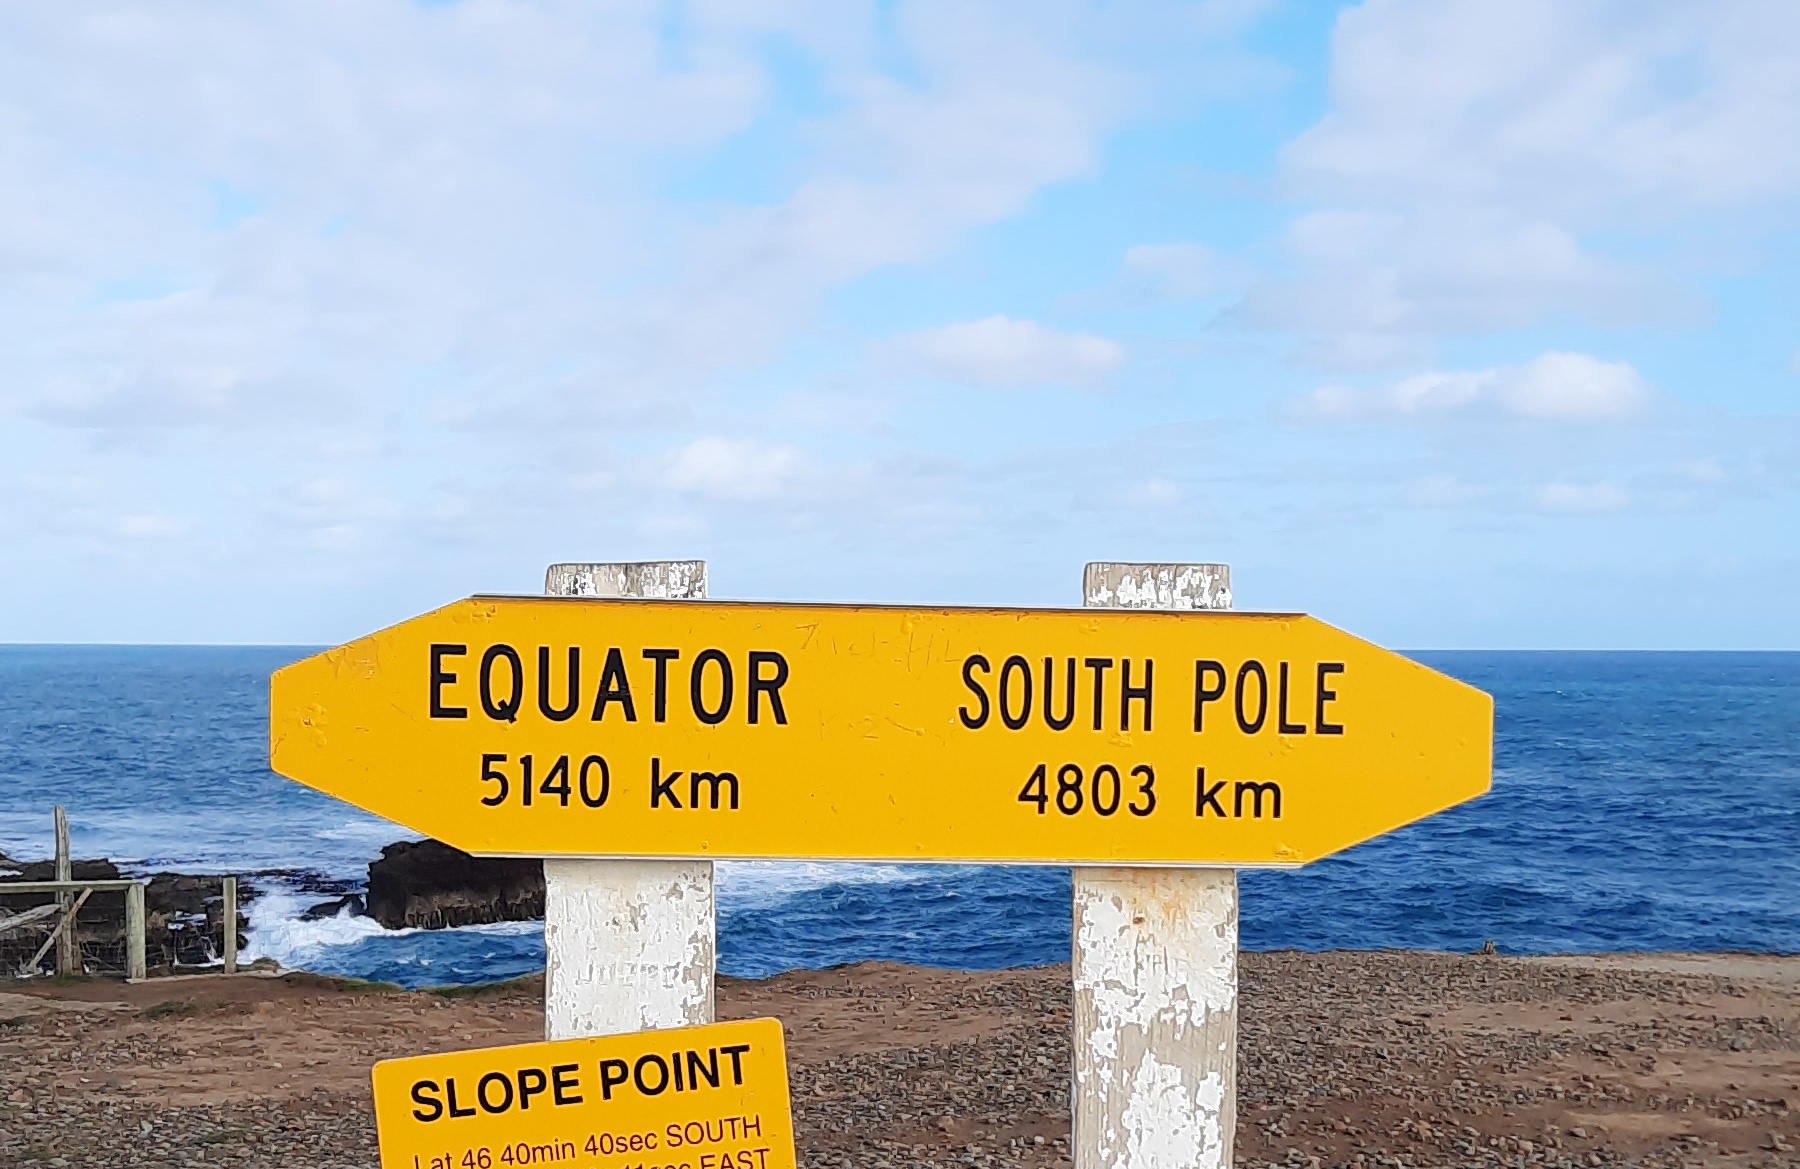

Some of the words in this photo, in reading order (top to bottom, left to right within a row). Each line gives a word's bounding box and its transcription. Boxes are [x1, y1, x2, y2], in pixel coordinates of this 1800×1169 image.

[429, 643, 789, 726] EQUATOR
[958, 654, 1154, 732] SOUTH
[1193, 659, 1345, 735] POLE
[480, 753, 610, 809] 5140
[650, 757, 739, 810] km
[1017, 763, 1157, 817] 4803
[1195, 767, 1281, 819] km
[410, 1063, 584, 1123] SLOPE
[599, 1044, 751, 1101] POINT
[500, 1138, 576, 1166] 40min
[584, 1132, 658, 1156] 40sec
[666, 1114, 762, 1148] SOUTH
